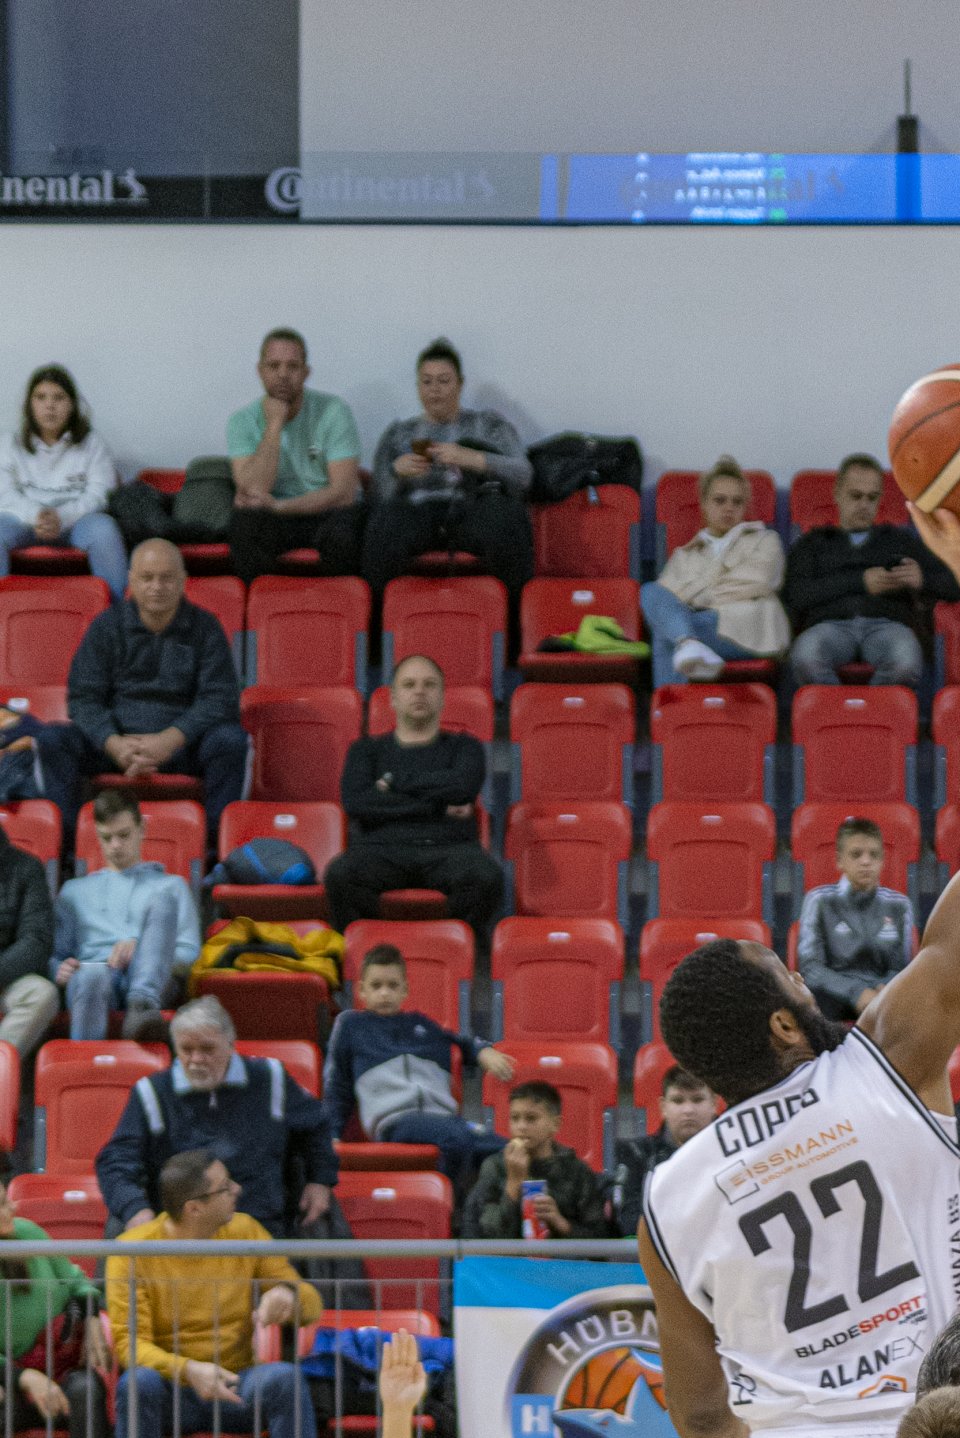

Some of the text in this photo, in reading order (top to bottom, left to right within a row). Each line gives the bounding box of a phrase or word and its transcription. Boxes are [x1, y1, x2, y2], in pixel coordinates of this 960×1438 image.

[729, 1119, 855, 1187] EISSMANN
[738, 1159, 921, 1334] 22
[547, 1308, 661, 1366] HÜBN
[794, 1295, 924, 1359] BLADESPORT
[819, 1329, 926, 1390] ALANEX
[520, 1403, 550, 1433] H
